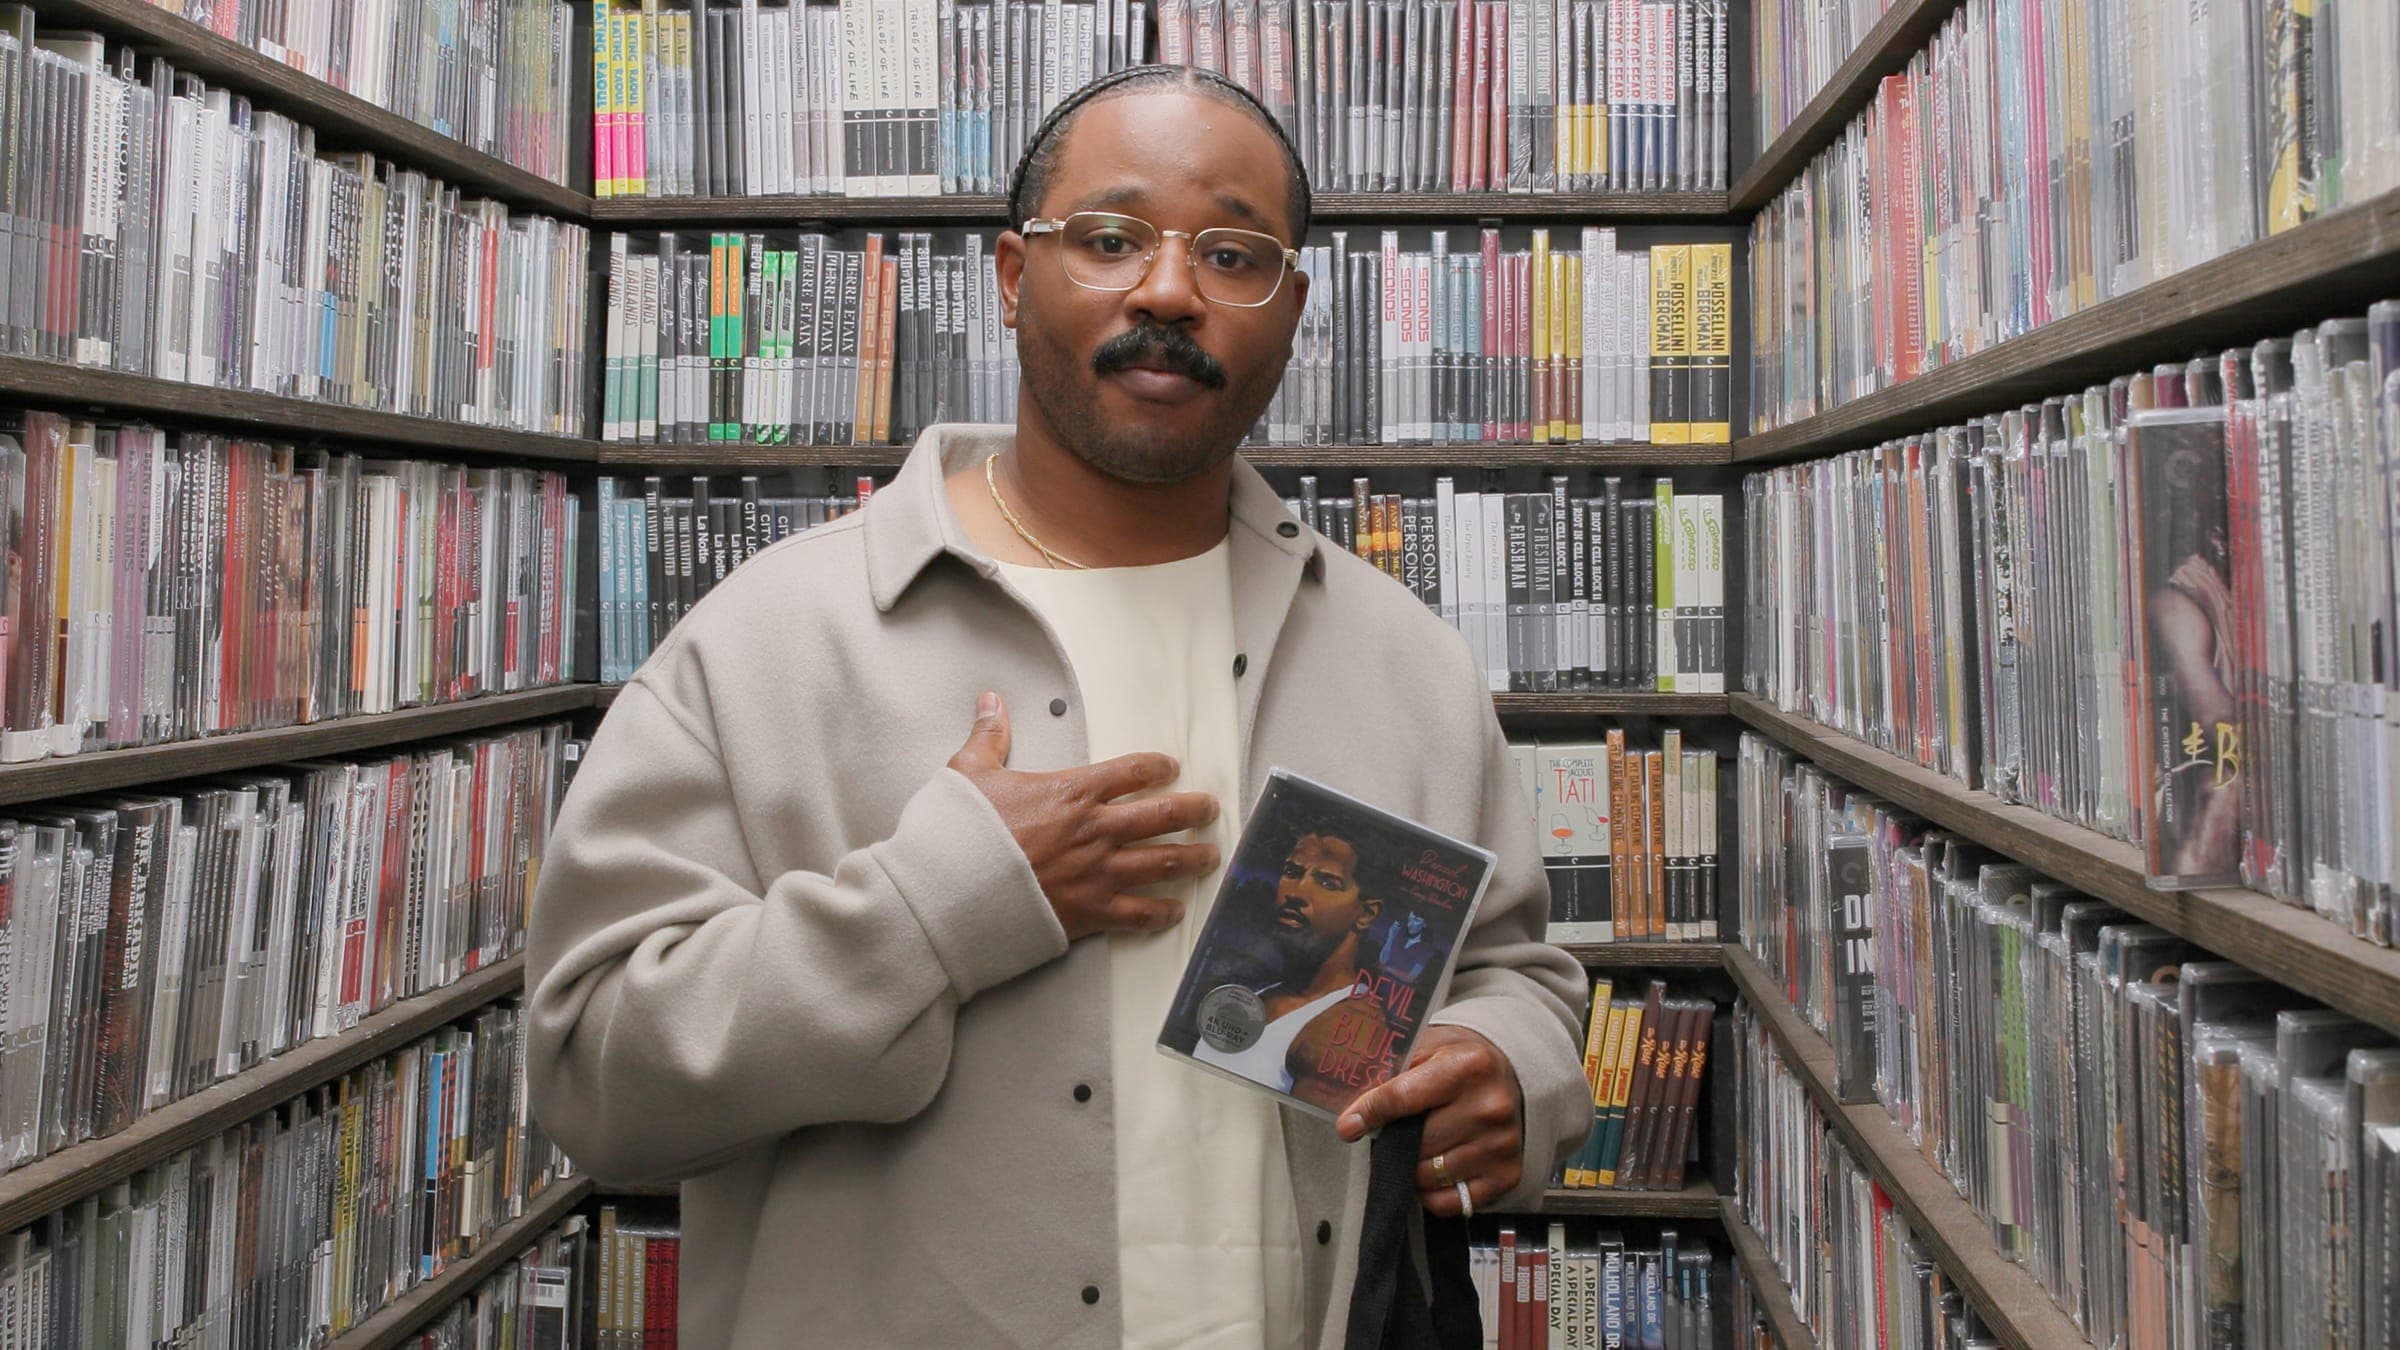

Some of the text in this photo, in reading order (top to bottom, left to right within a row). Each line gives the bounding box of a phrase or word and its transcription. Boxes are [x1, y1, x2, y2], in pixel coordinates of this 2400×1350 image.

[595, 3, 608, 109] EATING RAOUL
[968, 245, 979, 319] medium cool
[1385, 246, 1396, 321] SECONDS
[1401, 267, 1412, 342] SECONDS
[1418, 267, 1429, 342] SECONDS
[1657, 291, 1670, 351] BERGMAN
[1671, 282, 1684, 351] ROSSELLINI
[1697, 290, 1710, 351] BERGMAN
[1711, 282, 1725, 351] ROSSELLINI
[697, 515, 709, 564] La Notte
[714, 534, 724, 548] La
[745, 503, 756, 531] CITY
[760, 514, 770, 544] CITY
[1556, 521, 1566, 540] CELL
[1421, 516, 1436, 591] PERSONA
[1510, 525, 1526, 588] FRESHMAN
[1534, 528, 1550, 591] FRESHMAN
[1556, 541, 1566, 564] BLOCK
[1573, 542, 1583, 560] CELL
[1574, 562, 1583, 584] BLOCK
[2161, 726, 2170, 768] CRITERION
[1553, 769, 1595, 804] TATI
[127, 874, 150, 988] ARKADIN
[121, 947, 132, 990] REPORT
[1349, 968, 1416, 1022] DEVIL
[1330, 1011, 1405, 1067] BLUE
[1551, 1258, 1560, 1304] SPECIAL
[1585, 1277, 1594, 1322] SPECIAL
[1605, 1252, 1620, 1329] MULHOLLAND
[1551, 1306, 1560, 1330] DAY
[1585, 1325, 1594, 1347] DAY
